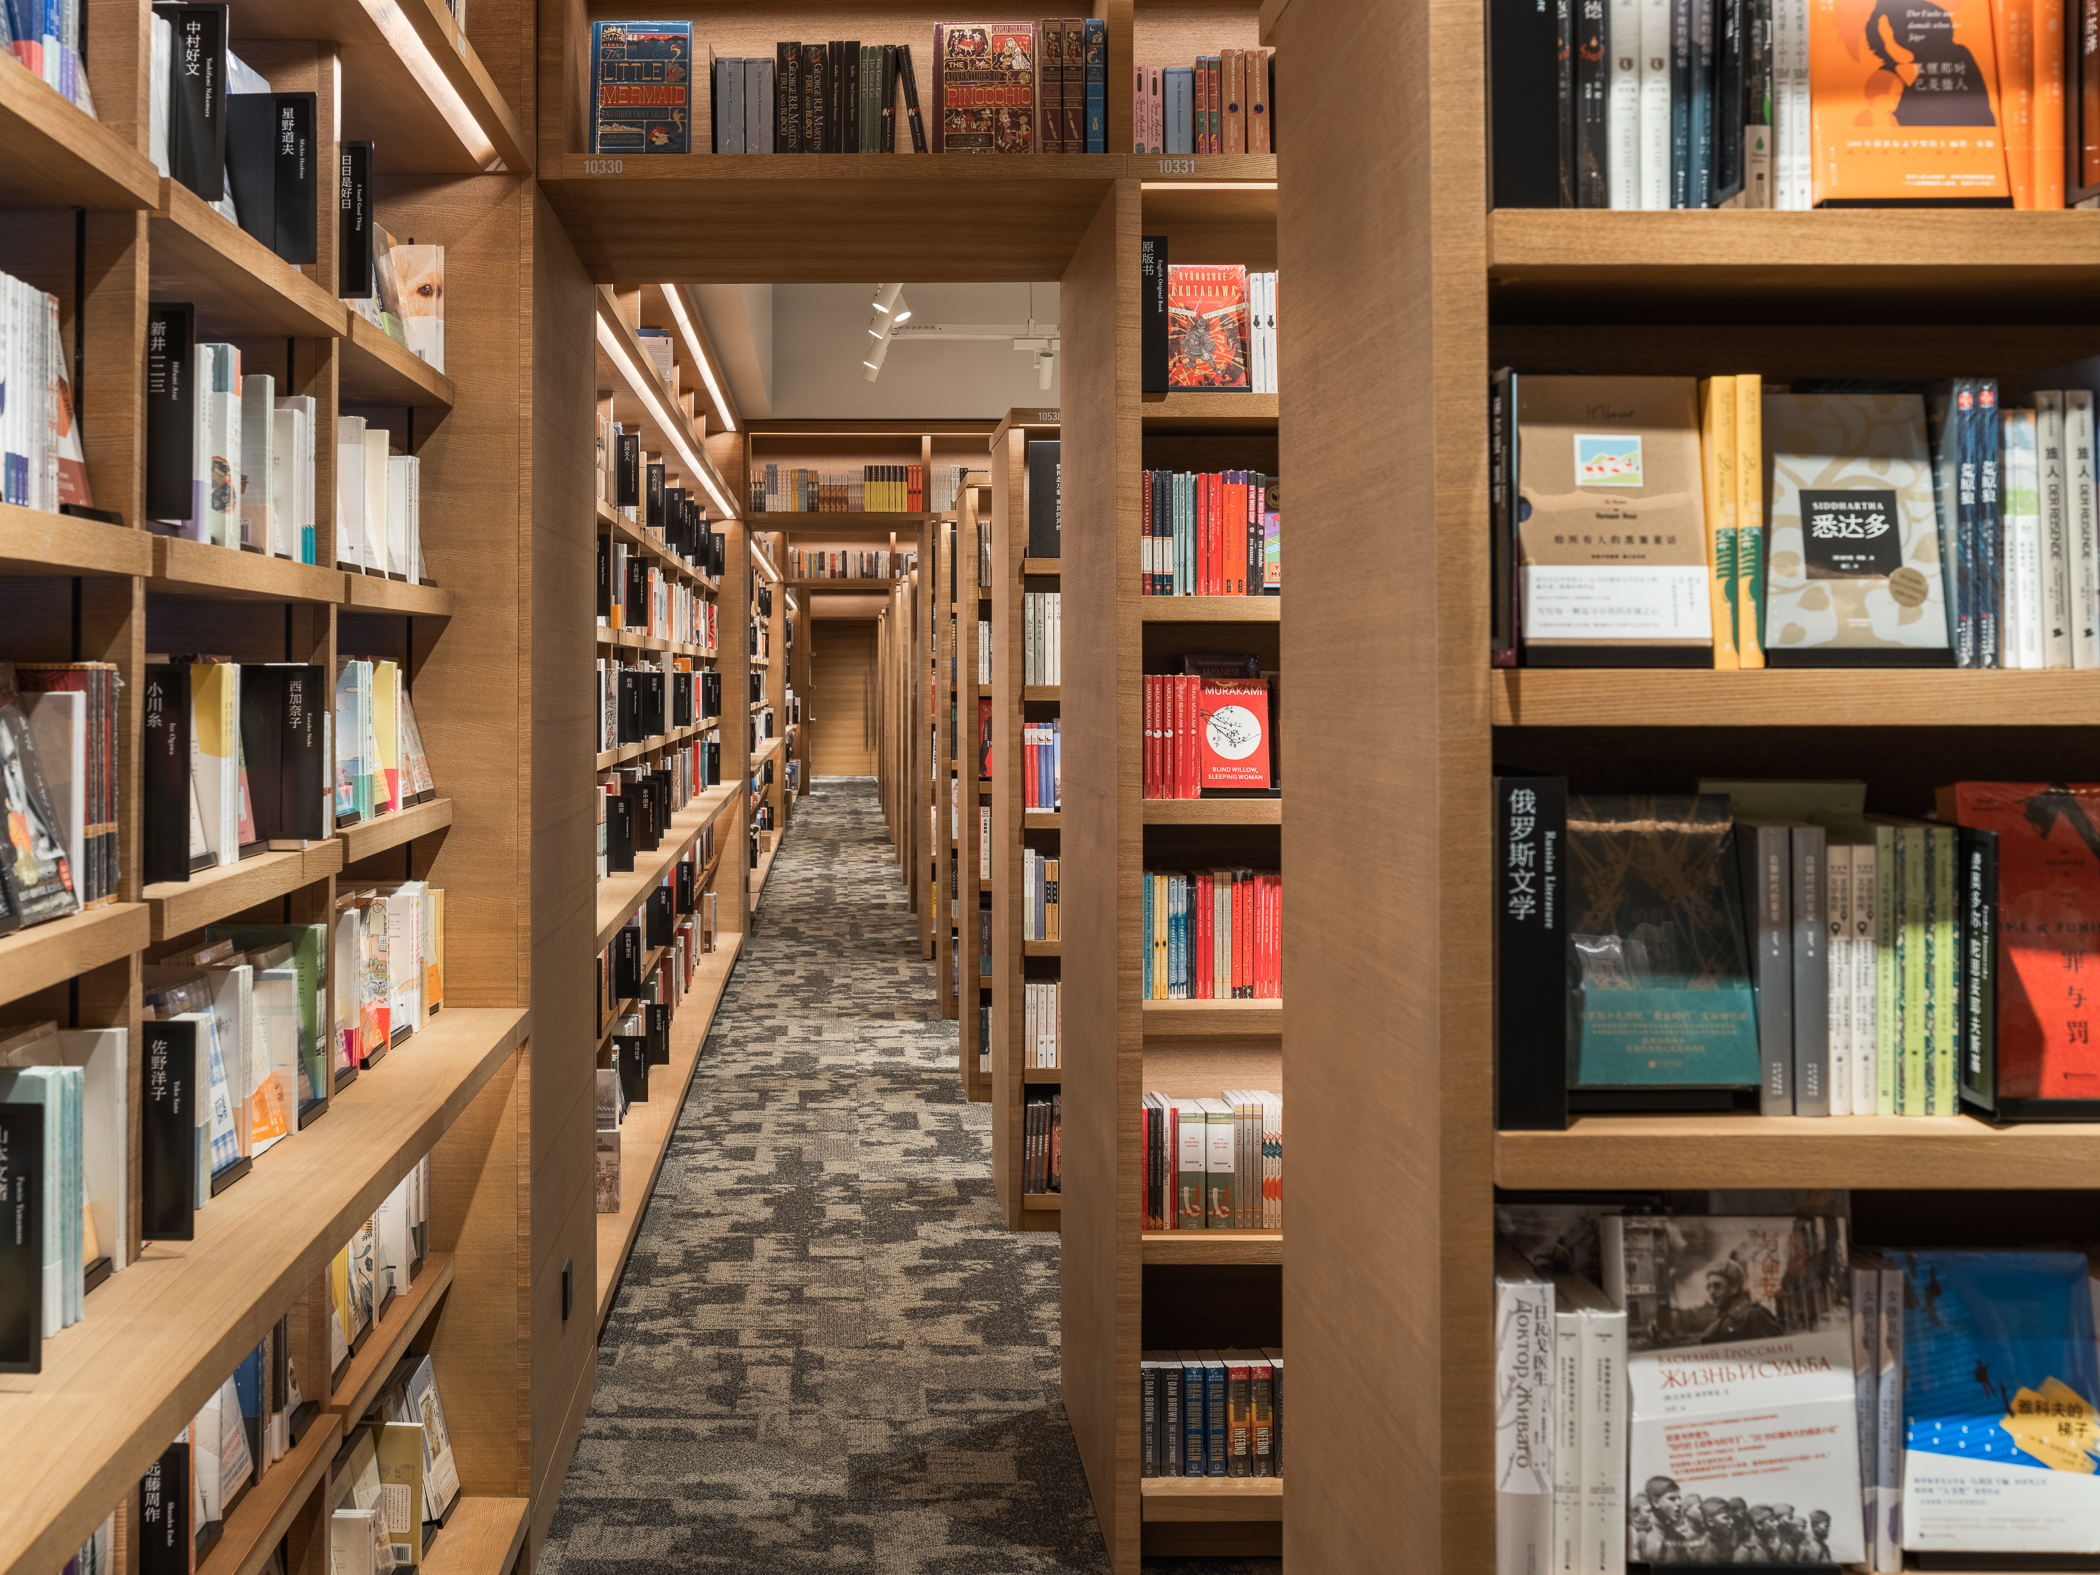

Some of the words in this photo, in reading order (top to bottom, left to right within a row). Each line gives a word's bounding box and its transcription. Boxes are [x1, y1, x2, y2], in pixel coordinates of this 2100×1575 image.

[185, 20, 201, 76] 中村好文
[604, 50, 623, 59] The
[604, 63, 663, 80] LITTLE
[947, 72, 991, 81] ADVENTURES
[1913, 62, 1966, 75] 狐狸那时
[602, 86, 685, 104] MERMAID
[947, 88, 1030, 105] PINOCCHIO
[1915, 78, 1969, 91] 已是猎人
[614, 110, 633, 118] OTHER
[634, 110, 649, 118] FAIRY
[651, 110, 668, 118] TALES
[1138, 96, 1146, 112] Jane
[1153, 100, 1161, 115] Jane
[282, 107, 294, 155] 星野道夫
[1138, 114, 1146, 138] Austen
[1153, 118, 1161, 141] Austen
[584, 159, 623, 174] 10330
[1158, 160, 1196, 174] 10331
[341, 155, 351, 209] 日日是好日
[1142, 241, 1154, 275] 原版书
[1179, 272, 1226, 281] RYŪNOSUKE
[1171, 285, 1236, 297] AKUTAGAWA
[150, 321, 167, 394] 新井一二三
[172, 361, 180, 383] Hifumi
[2046, 448, 2059, 478] 旅人
[2077, 448, 2090, 478] 旅人
[1812, 502, 1884, 511] SIDDHARTHA
[2048, 484, 2061, 506] DER
[2080, 484, 2091, 505] DER
[1811, 514, 1890, 540] 悉达多
[2048, 508, 2061, 560] REISENDE
[2080, 508, 2091, 560] REISENDE
[1206, 687, 1263, 695] MURAKAMI
[147, 682, 163, 727] 小川糸
[289, 681, 302, 728] 西加奈子
[168, 723, 176, 732] Ito
[168, 734, 176, 755] Ogawa
[619, 802, 624, 813] 故宫
[1508, 788, 1537, 921] 俄罗斯文学
[1544, 831, 1556, 874] Russian
[1544, 875, 1556, 929] Literature
[2062, 950, 2089, 1044] 罪与罚
[151, 1039, 168, 1102] 佐野洋子
[16, 1177, 25, 1202] Fumio
[16, 1204, 25, 1245] Yamamoto
[1762, 1232, 1782, 1299] 与命运
[1513, 1298, 1533, 1378] Доктор
[1657, 1350, 1720, 1366] ВАСИЛИЙ
[1724, 1343, 1794, 1359] ГРОССМАН
[1660, 1364, 1737, 1390] ЖИЗНЬ
[1740, 1362, 1756, 1380] И
[1758, 1356, 1832, 1379] СУДЬБА
[1145, 1381, 1154, 1395] DAN
[1168, 1381, 1177, 1396] DAN
[1188, 1384, 1201, 1399] DAN
[1209, 1384, 1223, 1399] DAN
[1145, 1397, 1154, 1422] BROWN
[1168, 1398, 1177, 1423] BROWN
[1188, 1402, 1201, 1429] BROWN
[1209, 1402, 1223, 1430] BROWN
[2018, 1399, 2083, 1419] 雅科夫的
[1515, 1384, 1533, 1469] Живаго
[2058, 1421, 2089, 1438] 梯子
[1188, 1434, 1201, 1461] ORIGIN
[1209, 1434, 1223, 1461] ORIGIN
[1234, 1428, 1246, 1455] INFERNO
[1257, 1427, 1269, 1455] INFERNO
[145, 1462, 160, 1522] 远藤周作
